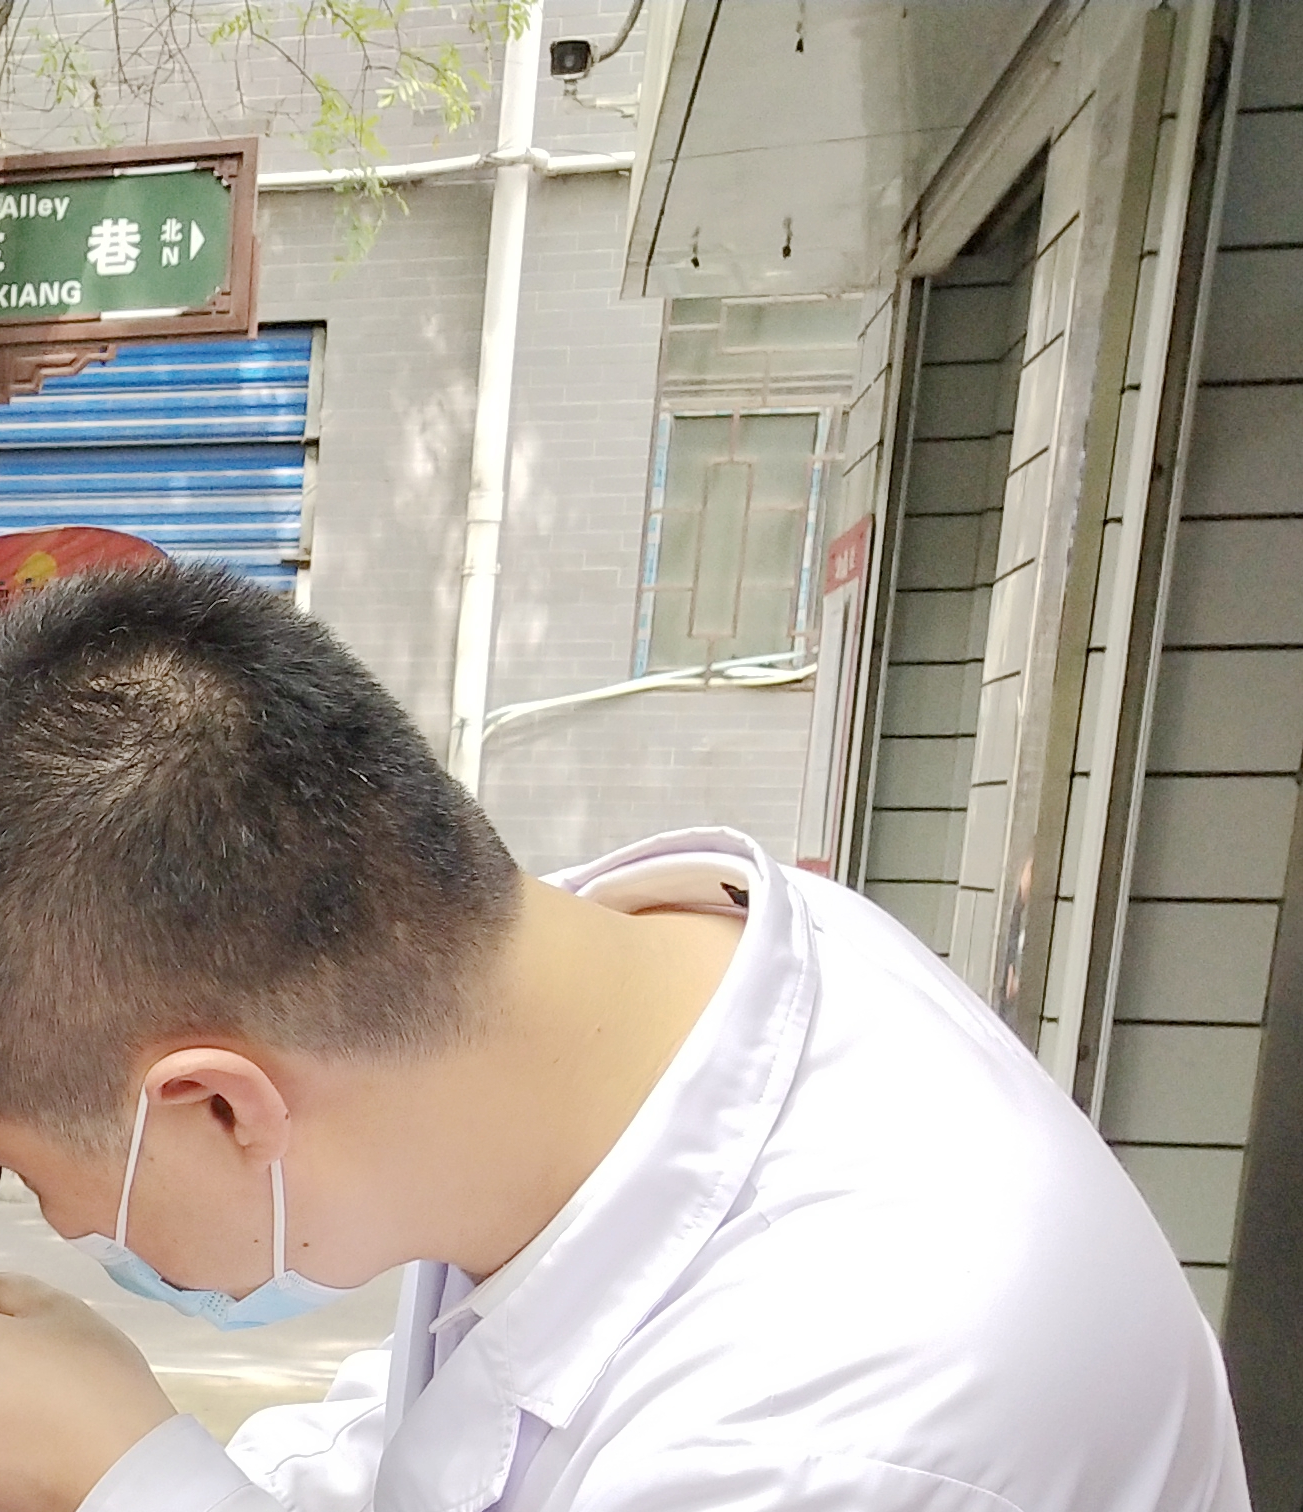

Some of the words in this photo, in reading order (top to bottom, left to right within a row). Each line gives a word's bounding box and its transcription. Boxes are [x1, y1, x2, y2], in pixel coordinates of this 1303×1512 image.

[0, 193, 71, 221] Alley
[160, 218, 183, 243] 北
[161, 246, 181, 268] N
